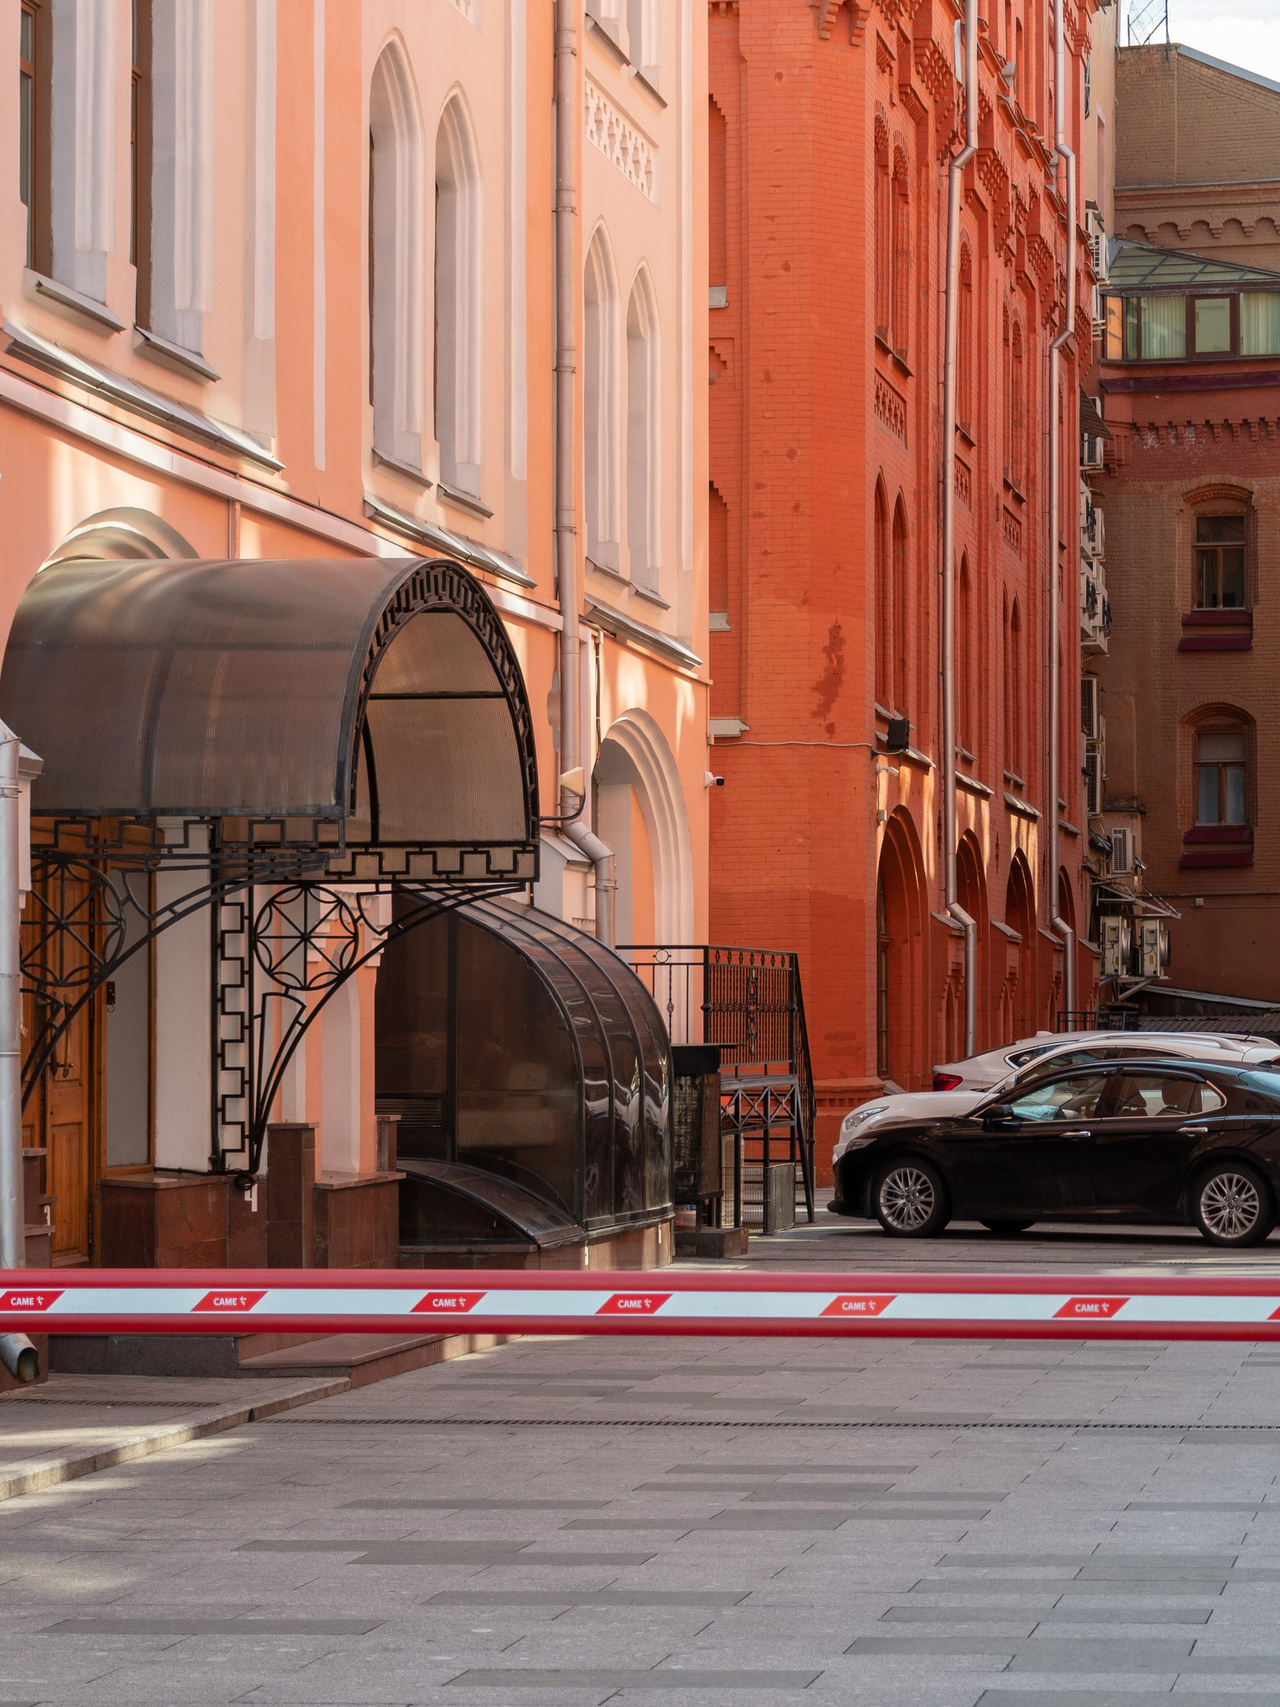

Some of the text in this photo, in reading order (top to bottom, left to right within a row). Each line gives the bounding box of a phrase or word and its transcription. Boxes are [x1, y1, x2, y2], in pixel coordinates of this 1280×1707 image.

[10, 1297, 35, 1306] CAME
[213, 1297, 237, 1306] CAME
[432, 1298, 457, 1307] CAME
[617, 1299, 642, 1308] CAME
[842, 1301, 866, 1311] CAME
[1075, 1303, 1100, 1312] CAME
